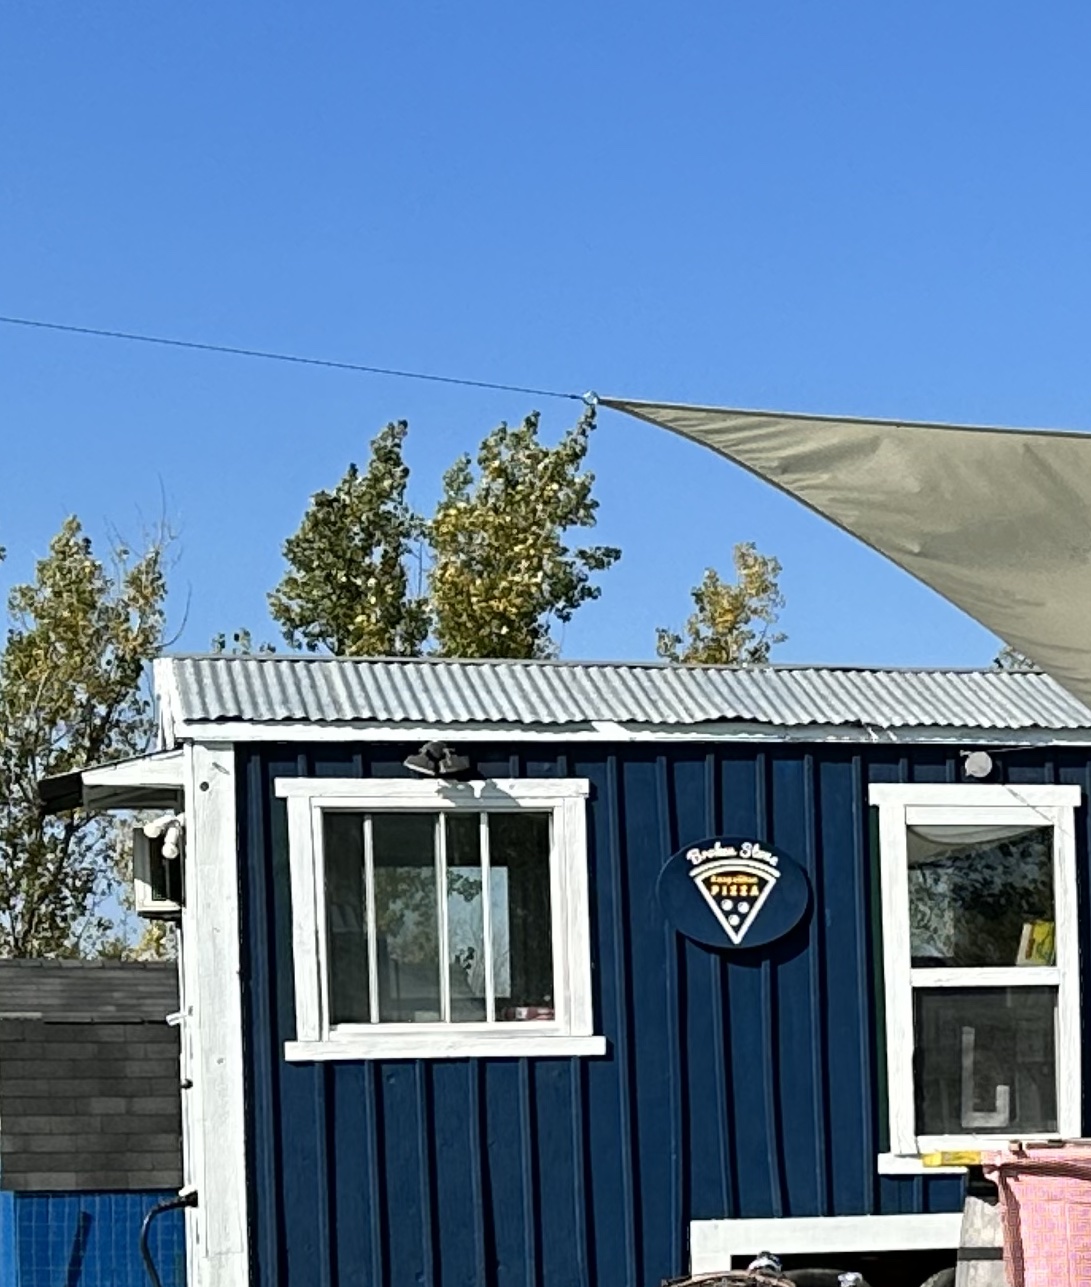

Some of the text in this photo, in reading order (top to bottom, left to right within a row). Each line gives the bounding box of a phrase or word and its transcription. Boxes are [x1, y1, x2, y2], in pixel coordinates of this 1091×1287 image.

[686, 841, 779, 866] Broken Stone
[710, 884, 760, 897] PIZZA
